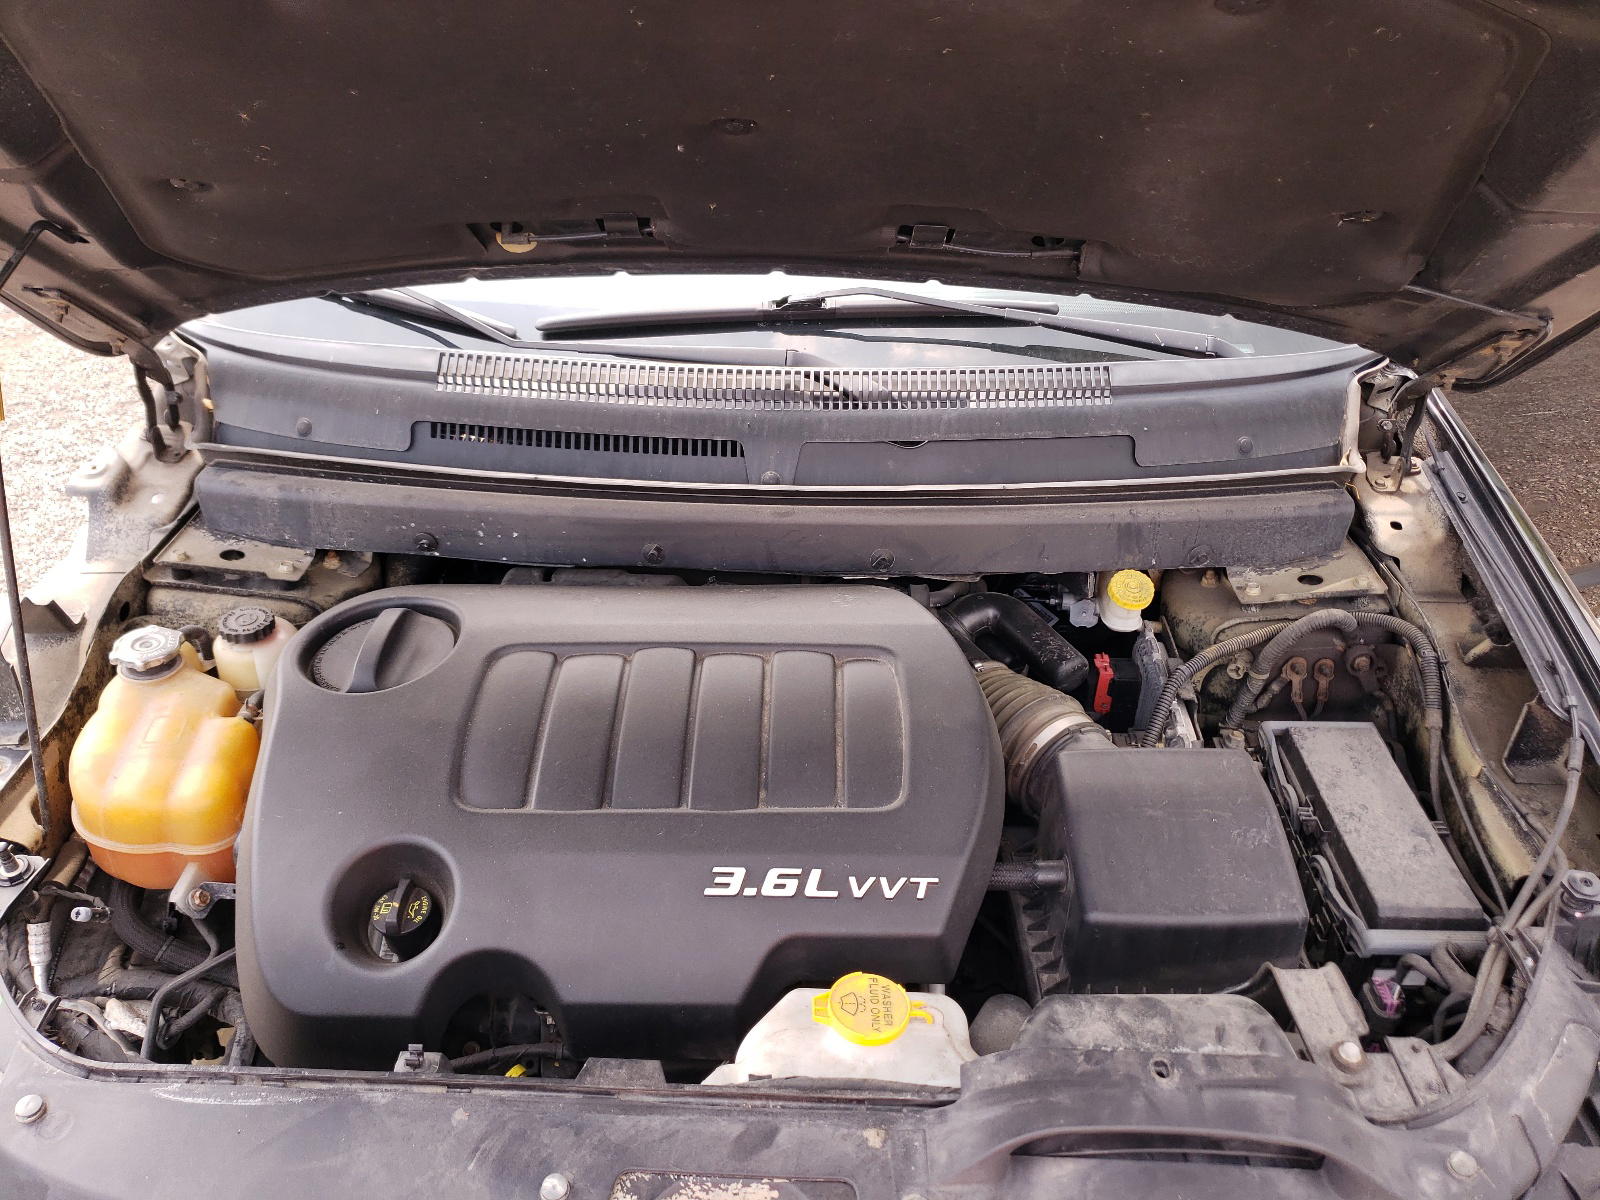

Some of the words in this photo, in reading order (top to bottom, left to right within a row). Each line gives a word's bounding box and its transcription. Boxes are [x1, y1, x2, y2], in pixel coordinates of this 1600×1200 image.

[703, 866, 839, 898] 3.6L
[848, 876, 940, 900] VVT
[412, 915, 423, 924] OIL
[868, 977, 880, 1005] FLUID
[881, 984, 894, 1026] WASHER
[870, 1008, 882, 1033] ONLY
